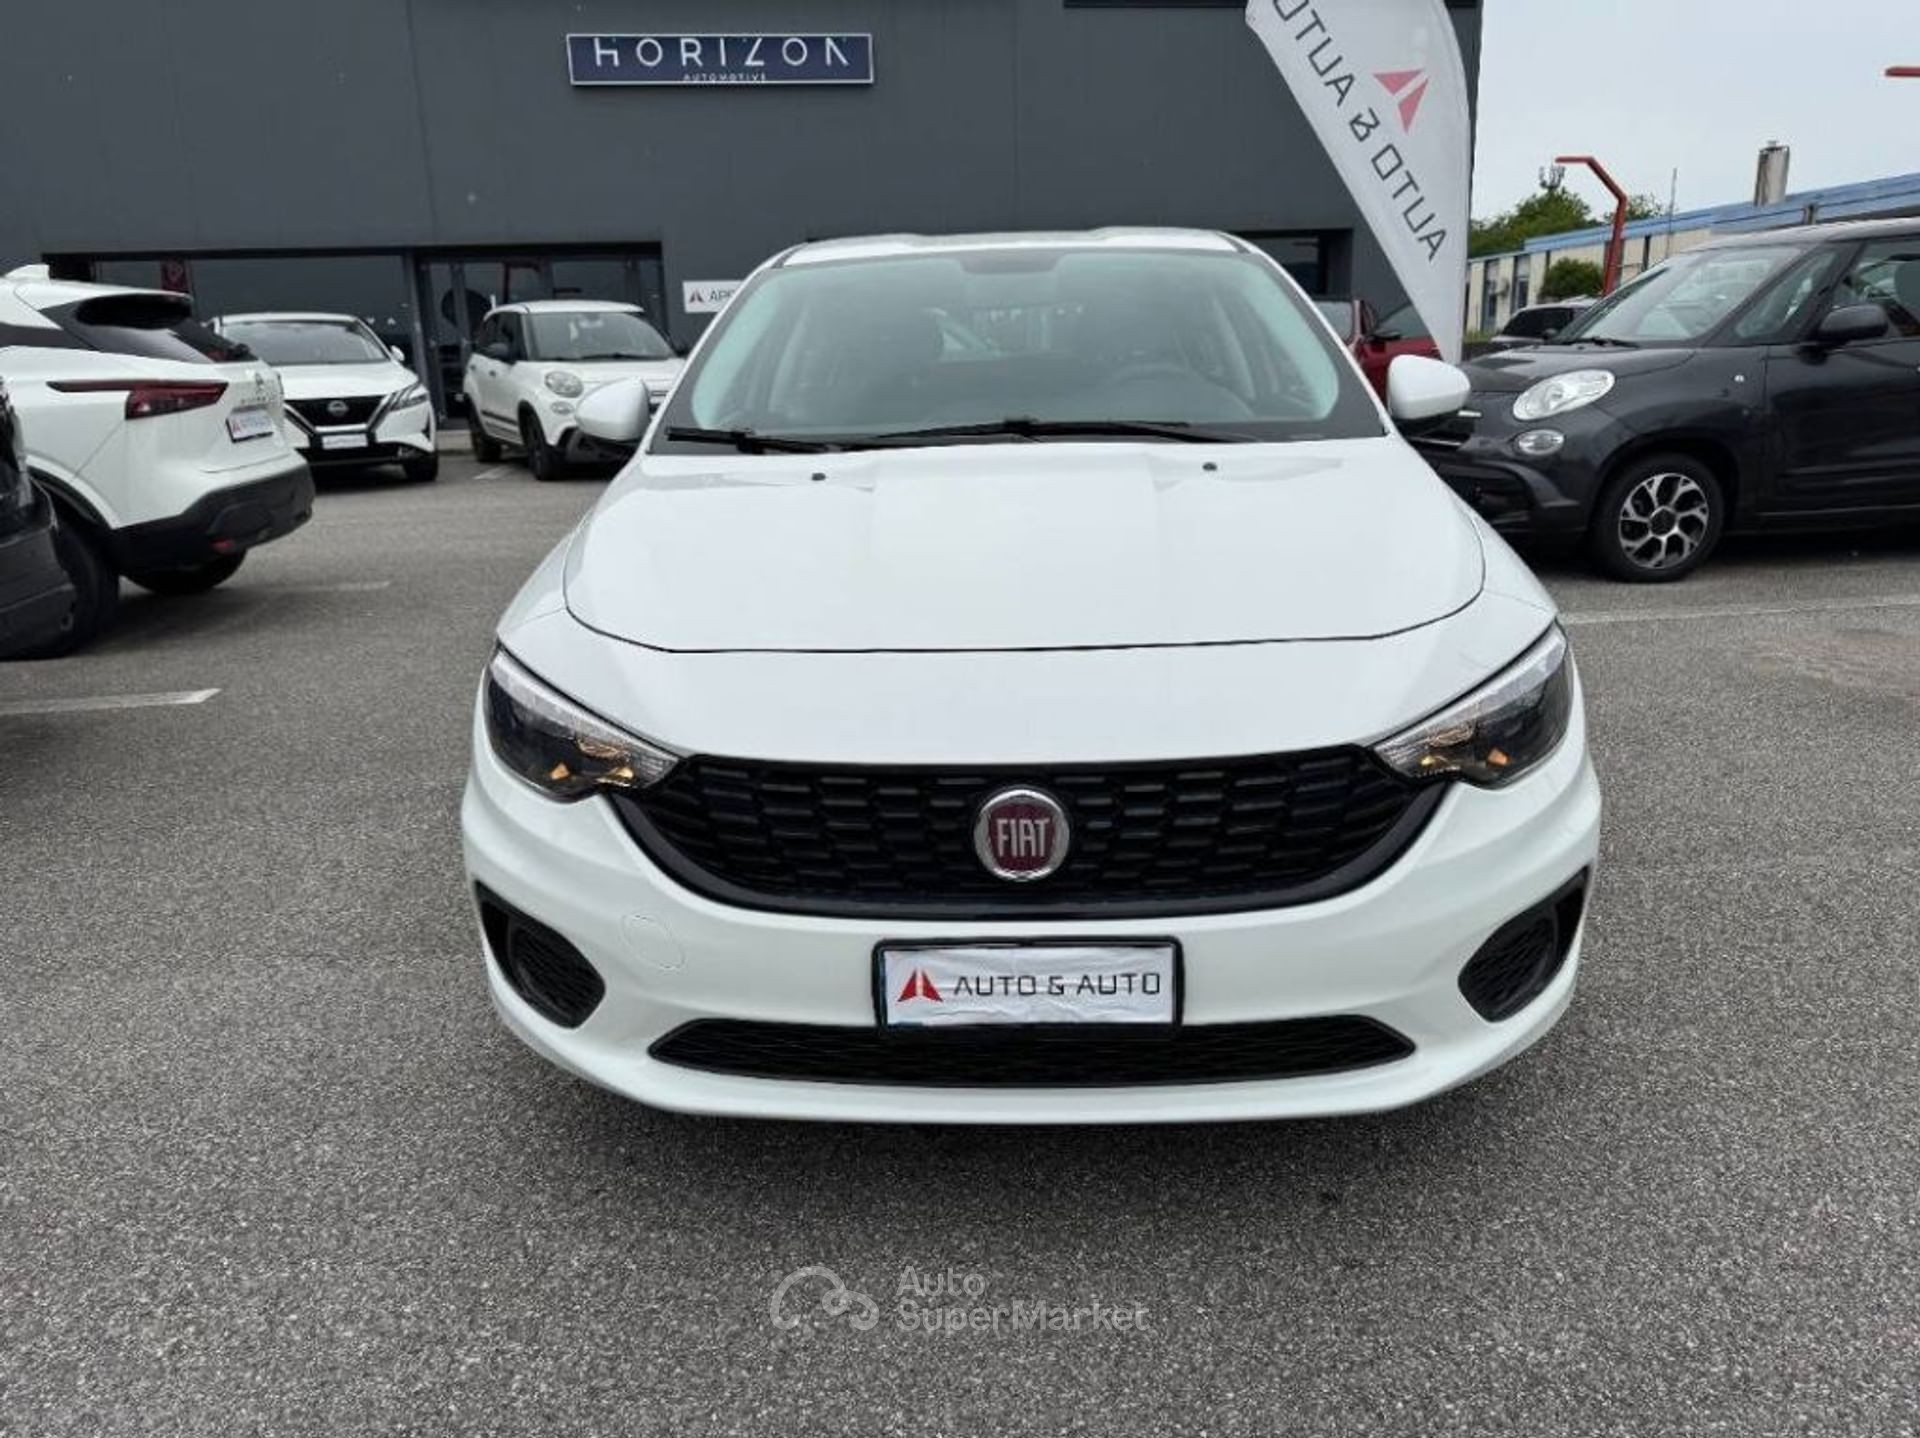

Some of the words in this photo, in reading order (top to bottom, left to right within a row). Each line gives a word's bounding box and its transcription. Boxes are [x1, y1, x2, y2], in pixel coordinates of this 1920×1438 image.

[592, 36, 850, 67] HORIZON
[683, 73, 766, 82] AUTOMOTIVE
[996, 818, 1050, 857] FIAT
[953, 974, 1037, 997] AUTO
[1047, 975, 1065, 996] &
[1076, 973, 1161, 996] AUTO
